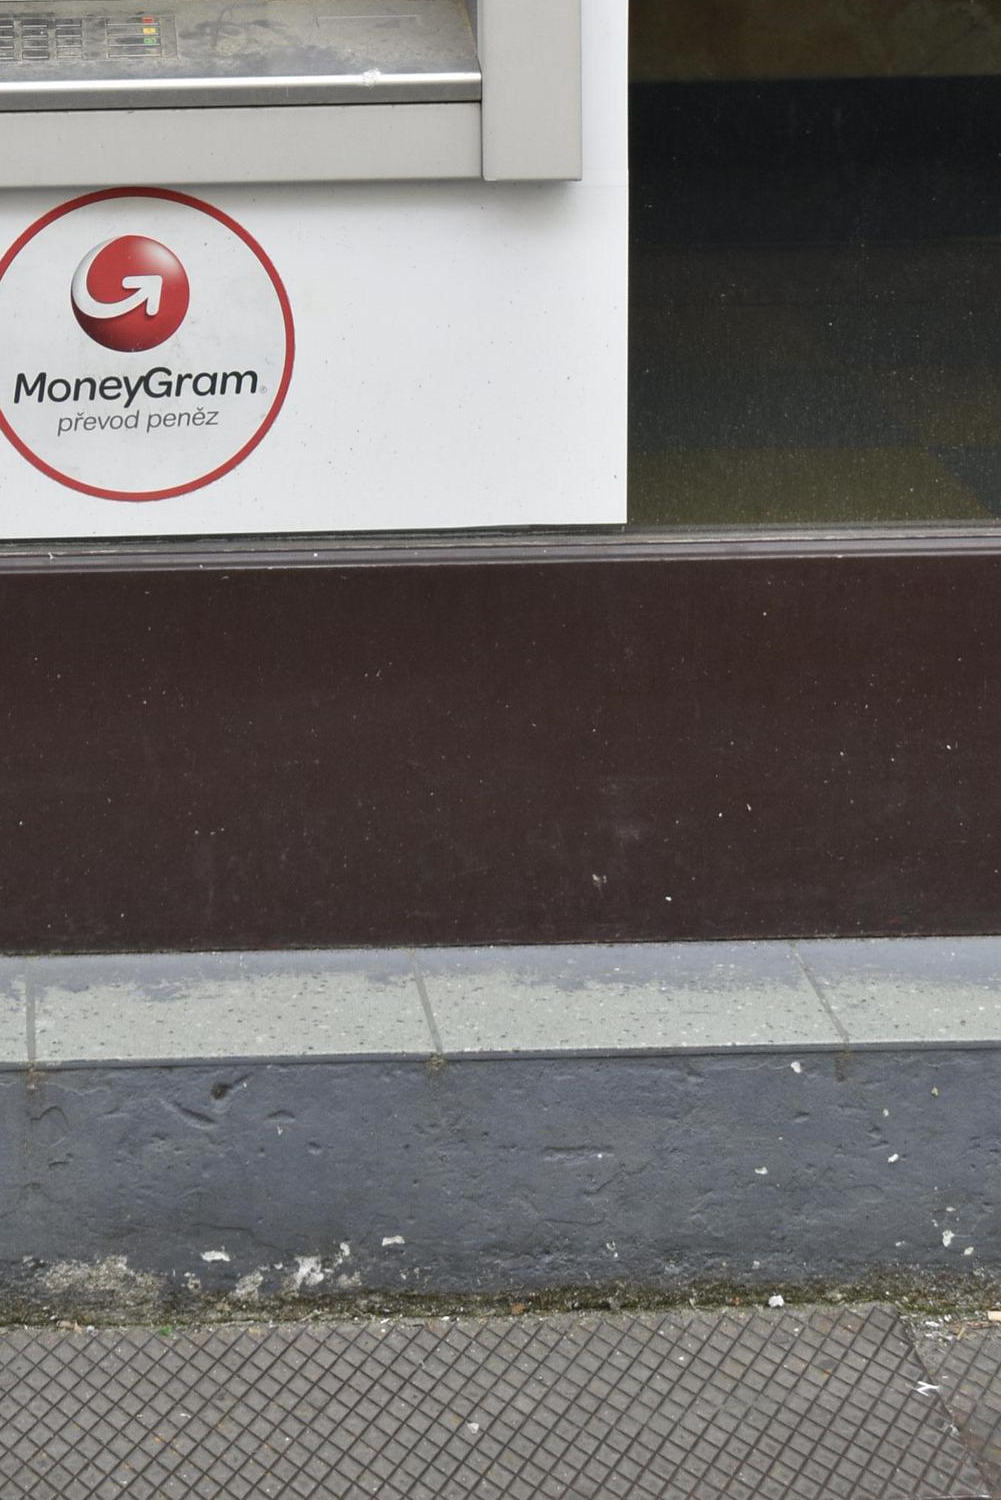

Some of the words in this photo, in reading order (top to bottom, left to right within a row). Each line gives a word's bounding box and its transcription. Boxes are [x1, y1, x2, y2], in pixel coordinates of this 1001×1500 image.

[13, 366, 258, 408] MoneyGram
[57, 410, 140, 436] převod
[146, 406, 219, 433] peněz
